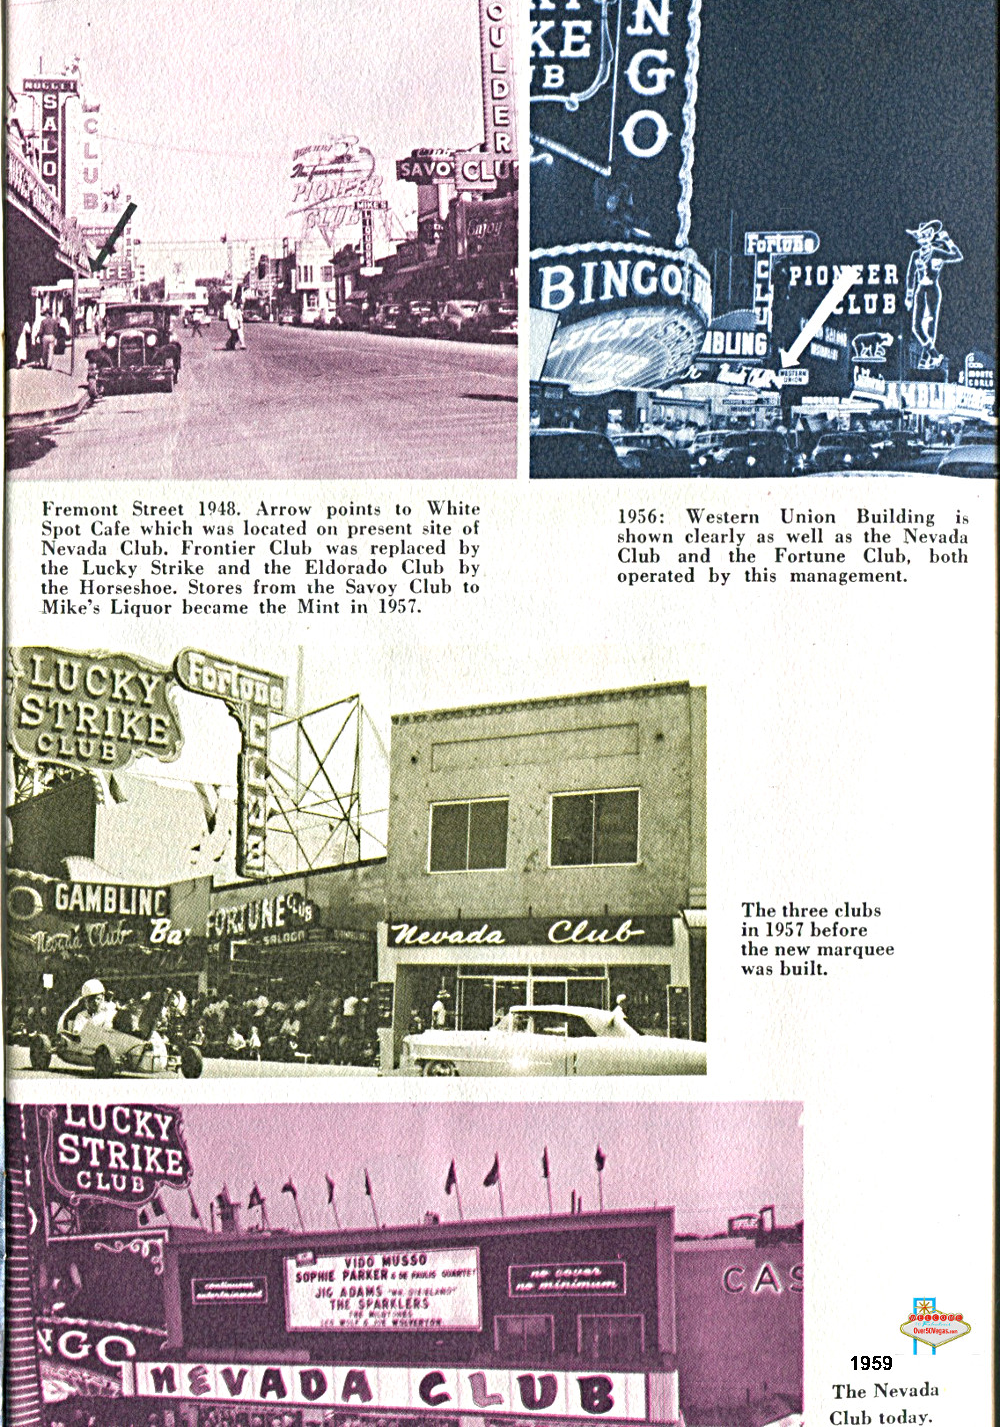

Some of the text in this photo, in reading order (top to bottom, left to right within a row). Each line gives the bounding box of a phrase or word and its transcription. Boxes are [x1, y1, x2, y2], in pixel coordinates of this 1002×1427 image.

[84, 118, 99, 210] CLUB
[462, 160, 519, 182] CLU
[538, 260, 684, 311] BINGO
[42, 499, 481, 520] Fremont Street 1948. Arrow points to White
[619, 508, 969, 527] 1956: Western Union Building is
[29, 653, 161, 707] LUCKY
[18, 693, 171, 747] STRIKE
[37, 732, 118, 762] CLUB
[205, 894, 286, 938] FORTUNE
[741, 901, 882, 918] The three clubs
[390, 923, 506, 945] Nevada
[547, 919, 646, 944] Club
[64, 1104, 174, 1142] LUCKY
[58, 1133, 185, 1176] STRIKE
[76, 1171, 146, 1194] CLUB
[344, 1253, 428, 1268] VIDO MUSSO
[295, 1269, 336, 1283] SOPHIE
[342, 1267, 389, 1282] PARKER
[529, 1269, 550, 1278] no
[340, 1285, 383, 1298] ADAMS
[515, 1278, 618, 1292] no minimum
[330, 1296, 430, 1311] THE SPARKLERS
[149, 1365, 616, 1415] NEVADA CLUB
[832, 1381, 939, 1400] The Nevada
[829, 1408, 933, 1426] Club today.
